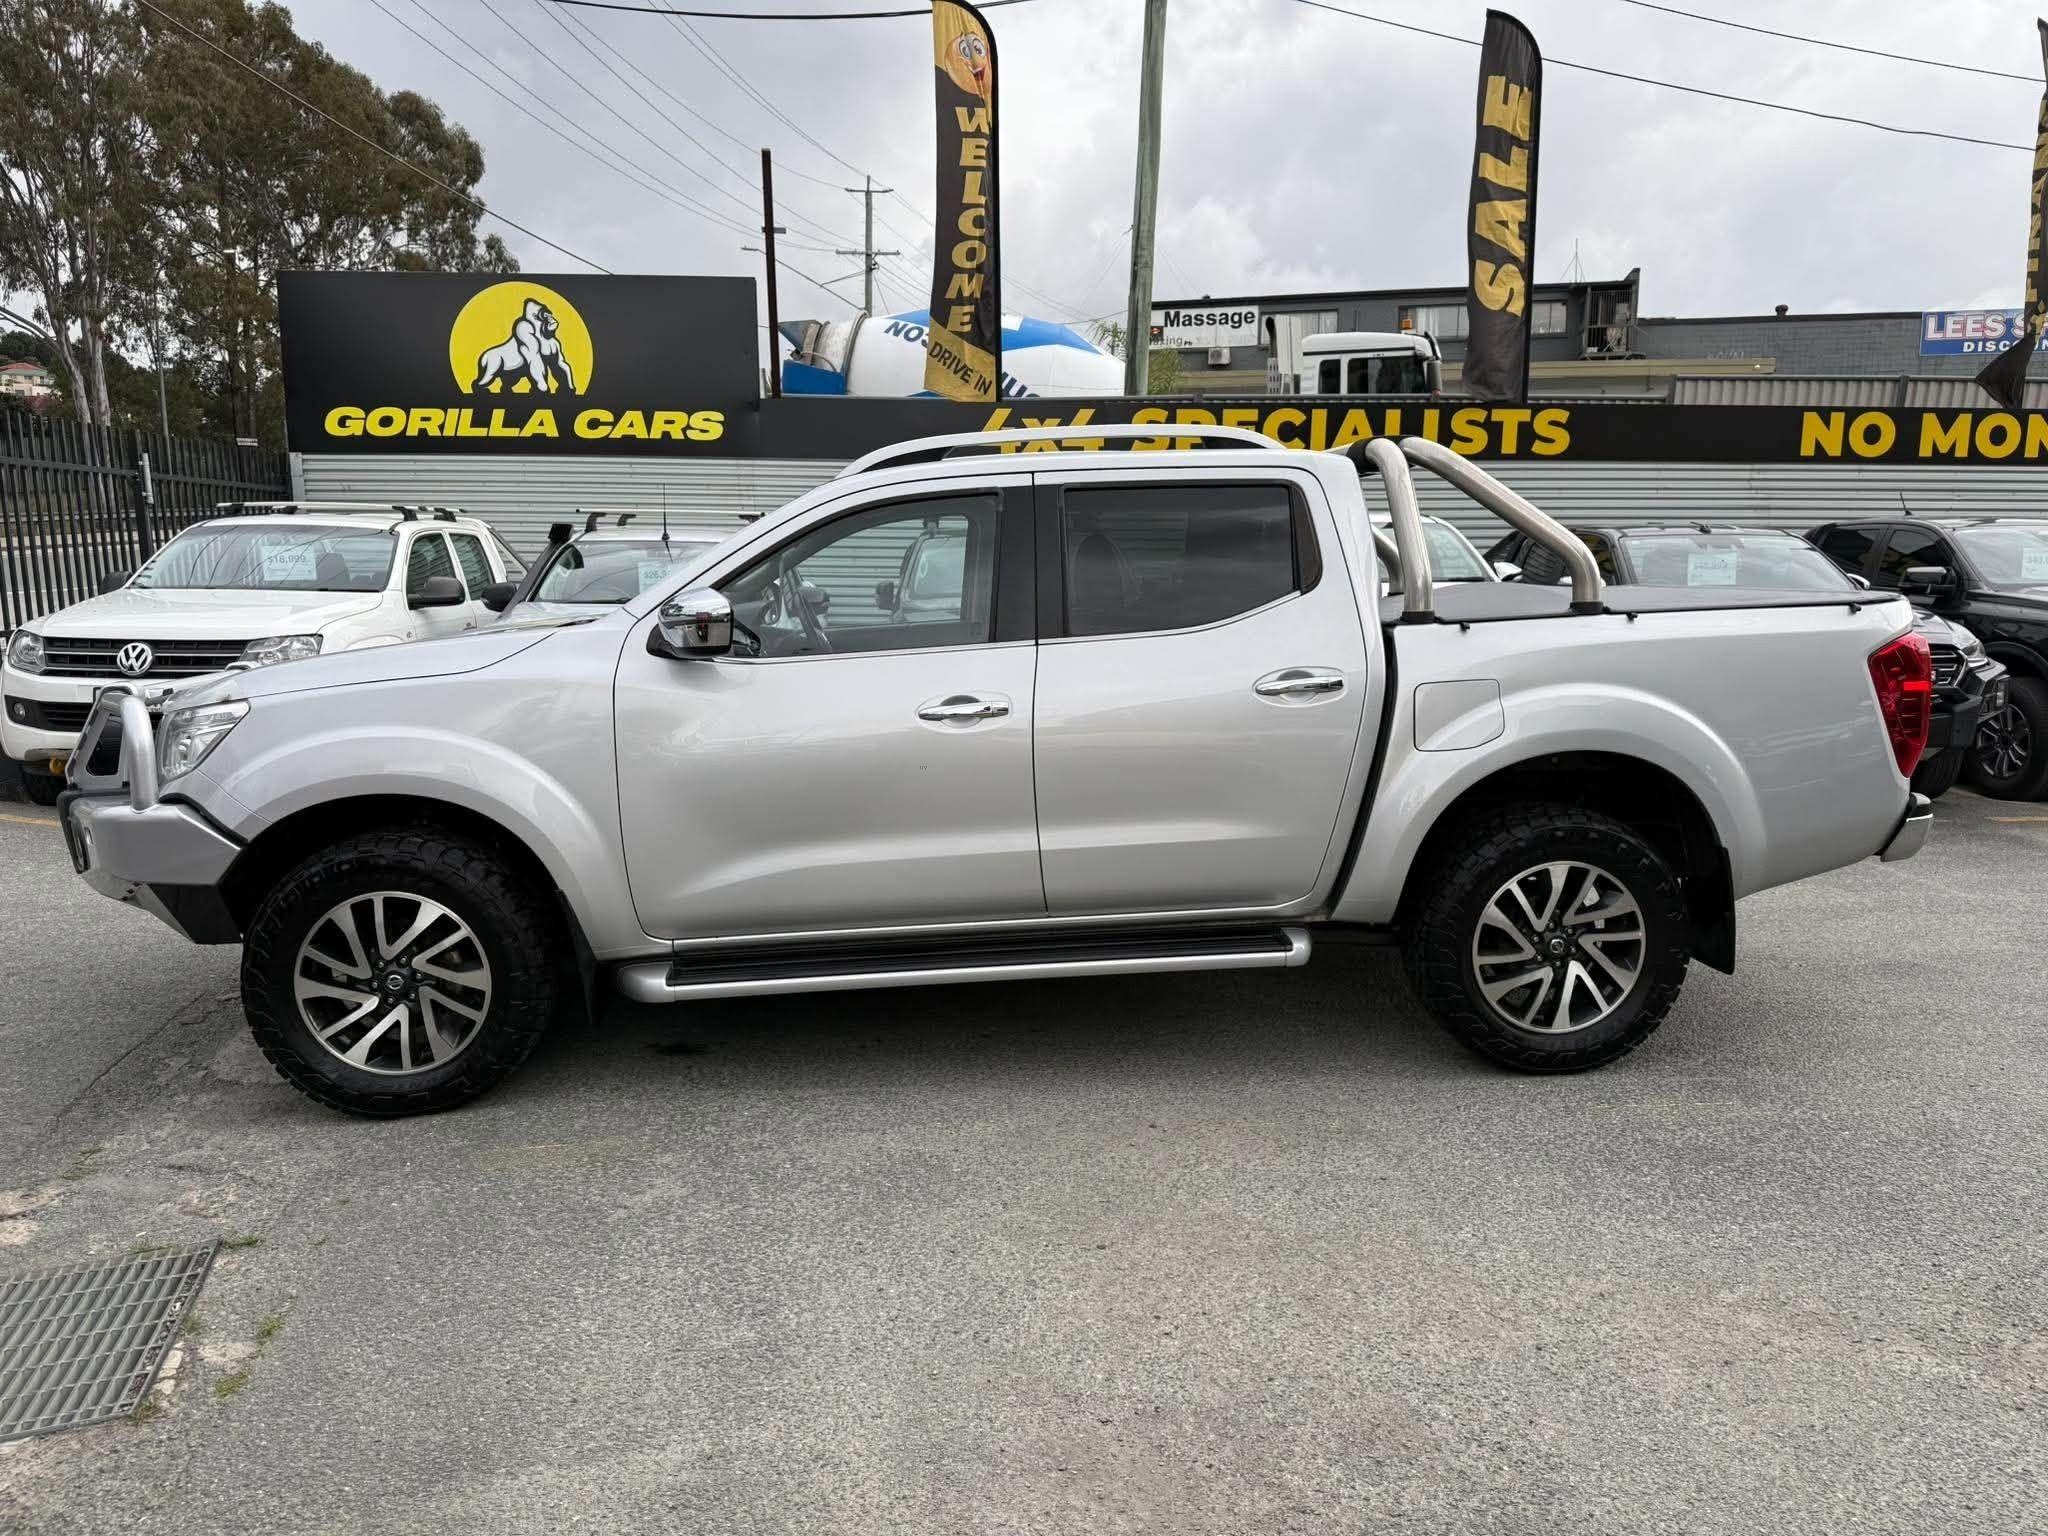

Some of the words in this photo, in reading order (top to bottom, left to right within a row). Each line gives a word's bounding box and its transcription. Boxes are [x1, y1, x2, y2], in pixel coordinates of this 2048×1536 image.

[945, 105, 991, 333] WELCOME
[1474, 75, 1533, 318] SALE
[1163, 310, 1256, 329] Massage
[1925, 312, 2006, 340] LEES
[929, 342, 974, 384] DRIVE
[973, 373, 993, 395] IN
[324, 406, 559, 438] GORILLA
[573, 408, 725, 441] CARS
[1800, 411, 1896, 458] NO
